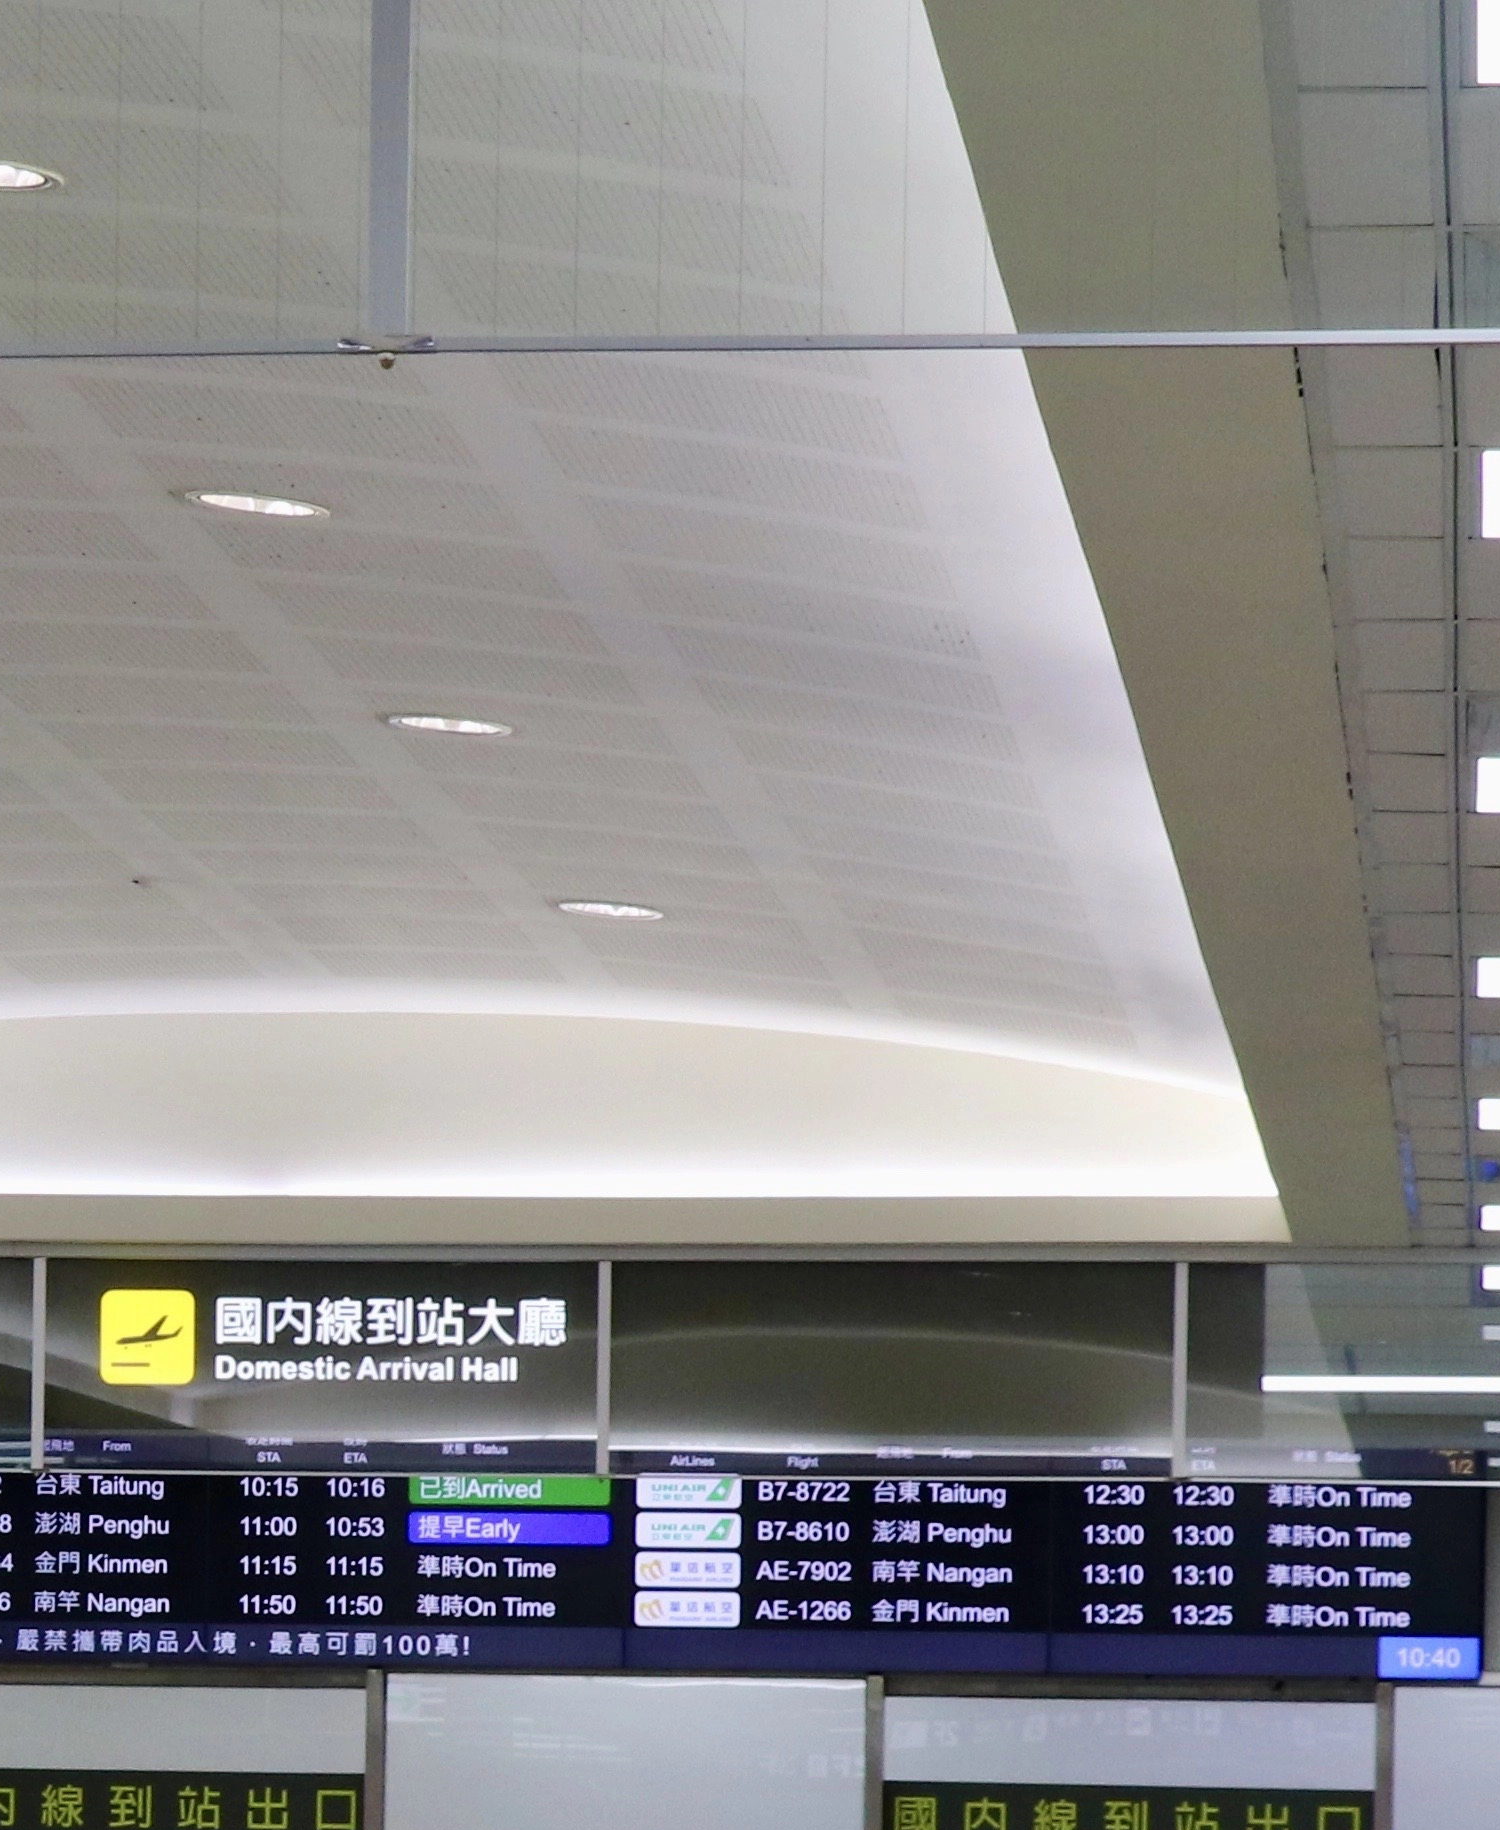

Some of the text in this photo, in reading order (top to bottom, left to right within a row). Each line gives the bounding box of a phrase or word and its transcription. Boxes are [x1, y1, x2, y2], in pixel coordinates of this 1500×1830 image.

[215, 1297, 567, 1346] 國內線到站大廳
[215, 1356, 517, 1382] Domestic Arrival Hall
[103, 1441, 132, 1452] From
[257, 1452, 368, 1464] STA ETA
[473, 1443, 509, 1456] Status
[1101, 1459, 1127, 1471] STA
[36, 1474, 81, 1496] 台東
[89, 1477, 164, 1501] Taitung
[240, 1477, 298, 1497] 10:15
[327, 1478, 385, 1498] 10:16
[758, 1482, 850, 1502] B7-8722
[873, 1482, 920, 1504] 台東
[927, 1483, 1006, 1507] Taitung
[1084, 1485, 1145, 1506] 12:30
[1173, 1486, 1234, 1507] 12:30
[1356, 1487, 1412, 1508] Time
[35, 1512, 80, 1534] 澎湖
[89, 1515, 169, 1539] Penghu
[241, 1517, 297, 1536] 11:00
[326, 1517, 384, 1536] 10:53
[758, 1521, 849, 1541] B7-8610
[873, 1520, 920, 1543] 澎湖
[928, 1523, 1011, 1548] Penghu
[1084, 1525, 1144, 1544] 13:00
[1173, 1525, 1233, 1546] 13:00
[1355, 1527, 1411, 1547] Time
[35, 1551, 80, 1574] 金門
[88, 1554, 167, 1573] Kinmen
[240, 1556, 296, 1575] 11:15
[326, 1557, 383, 1576] 11:15
[503, 1558, 556, 1578] Time
[756, 1561, 851, 1581] AE-7902
[873, 1560, 920, 1582] 南竿
[927, 1563, 1012, 1587] Nangan
[1083, 1564, 1144, 1584] 13:10
[1172, 1565, 1233, 1585] 13:10
[1355, 1567, 1411, 1587] Time
[34, 1591, 80, 1612] 南竿
[88, 1593, 169, 1617] Nangan
[240, 1595, 296, 1614] 11:50
[326, 1596, 382, 1615] 11:50
[503, 1597, 555, 1617] Time
[756, 1600, 851, 1620] AE-1266
[872, 1599, 919, 1622] 金門
[927, 1602, 1009, 1622] Kinmen
[1083, 1604, 1143, 1624] 13:25
[1172, 1605, 1233, 1625] 13:25
[1354, 1607, 1410, 1627] Time
[1398, 1648, 1460, 1667] 10:40
